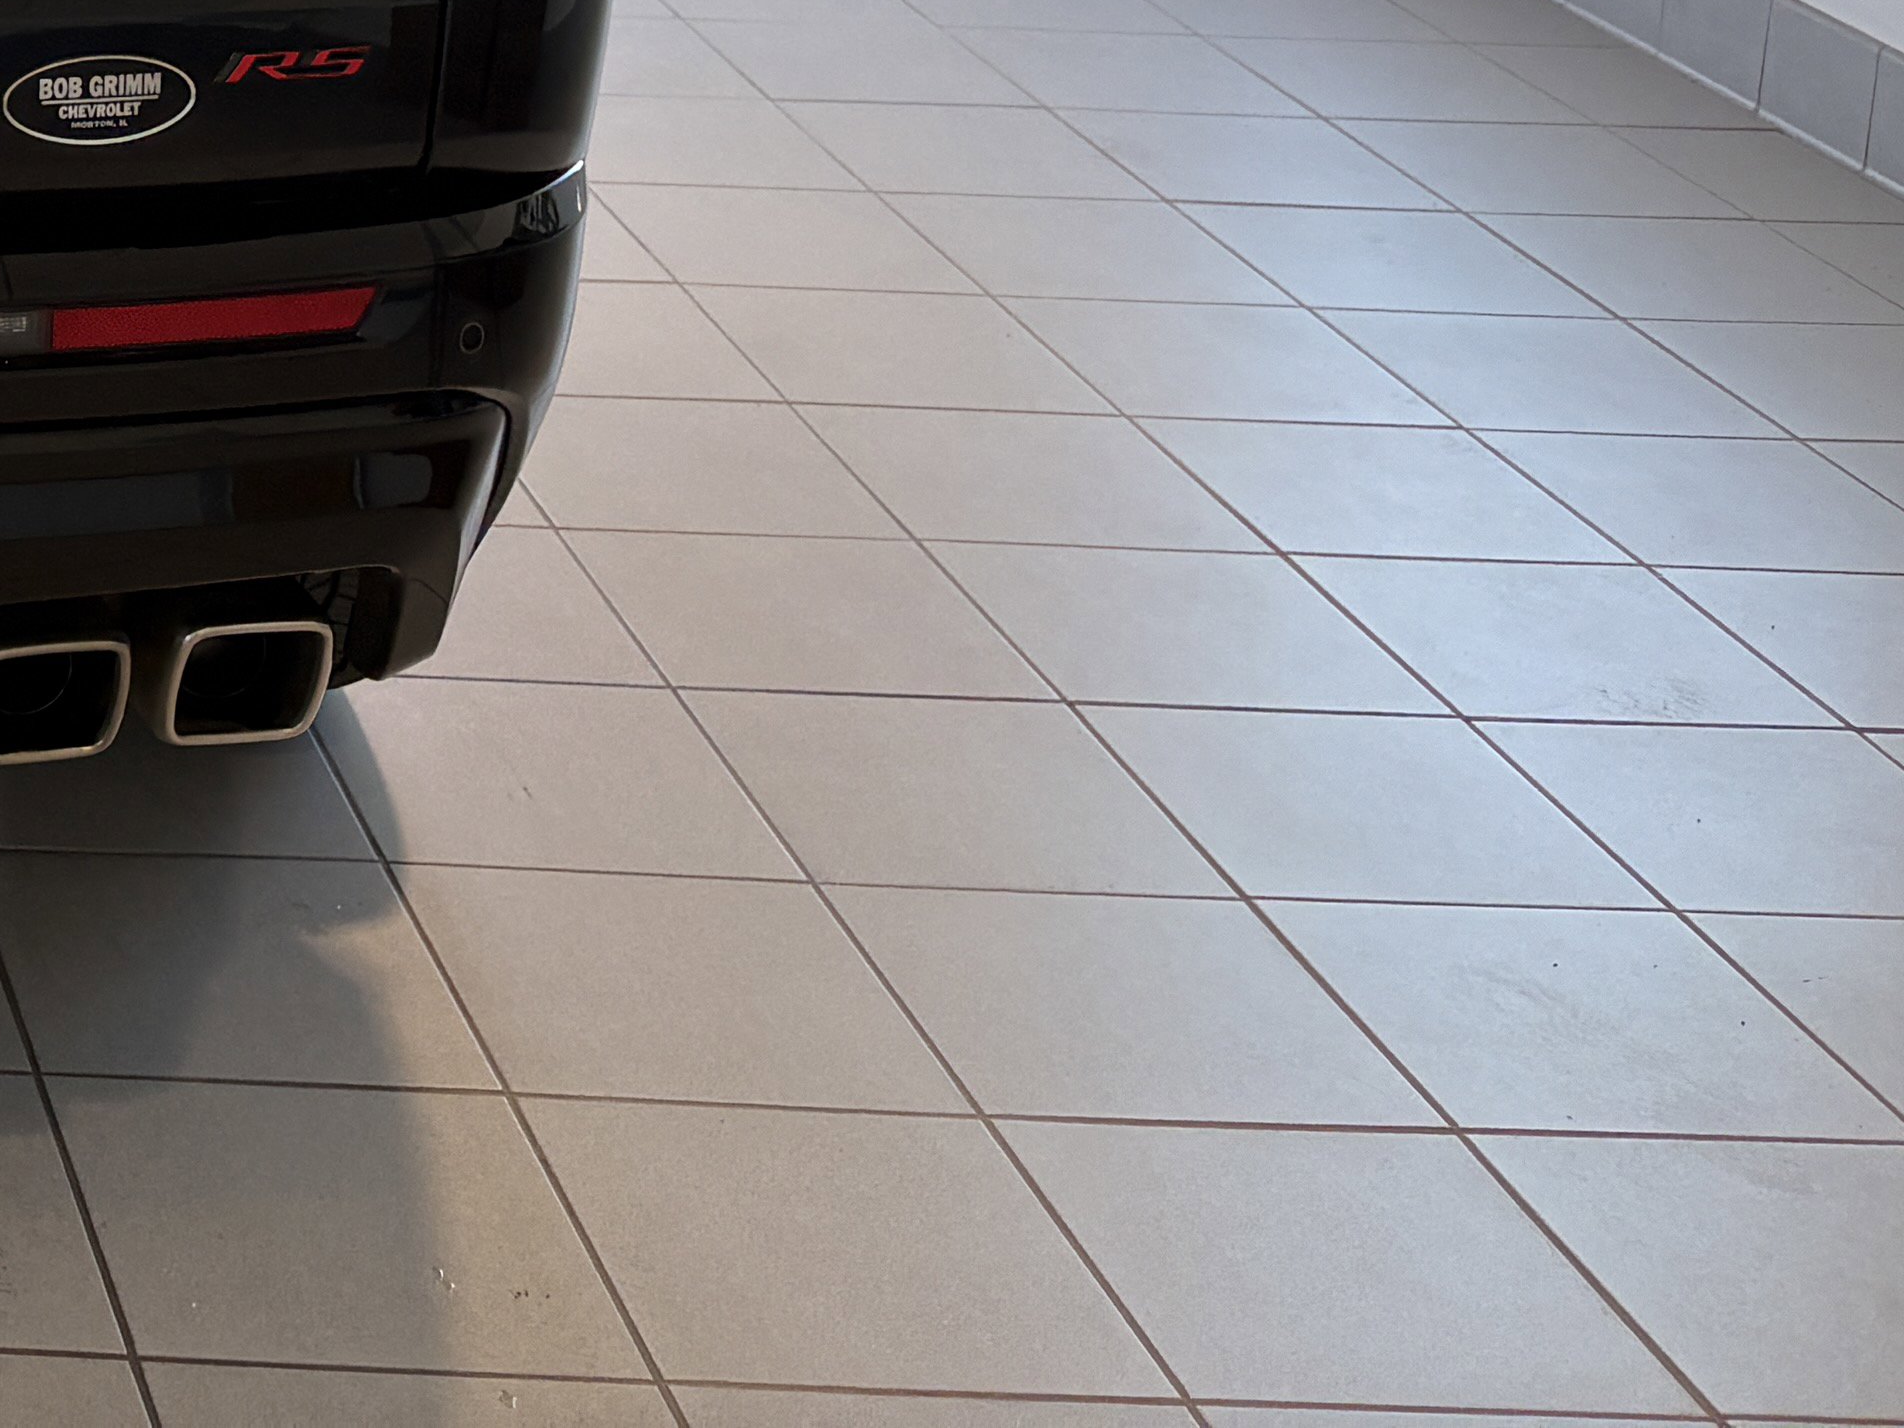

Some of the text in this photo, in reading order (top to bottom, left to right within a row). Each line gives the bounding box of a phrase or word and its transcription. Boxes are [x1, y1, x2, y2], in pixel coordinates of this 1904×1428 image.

[224, 45, 371, 85] RS
[39, 72, 162, 100] BOB GRIMM
[58, 101, 141, 120] CHEVROLET
